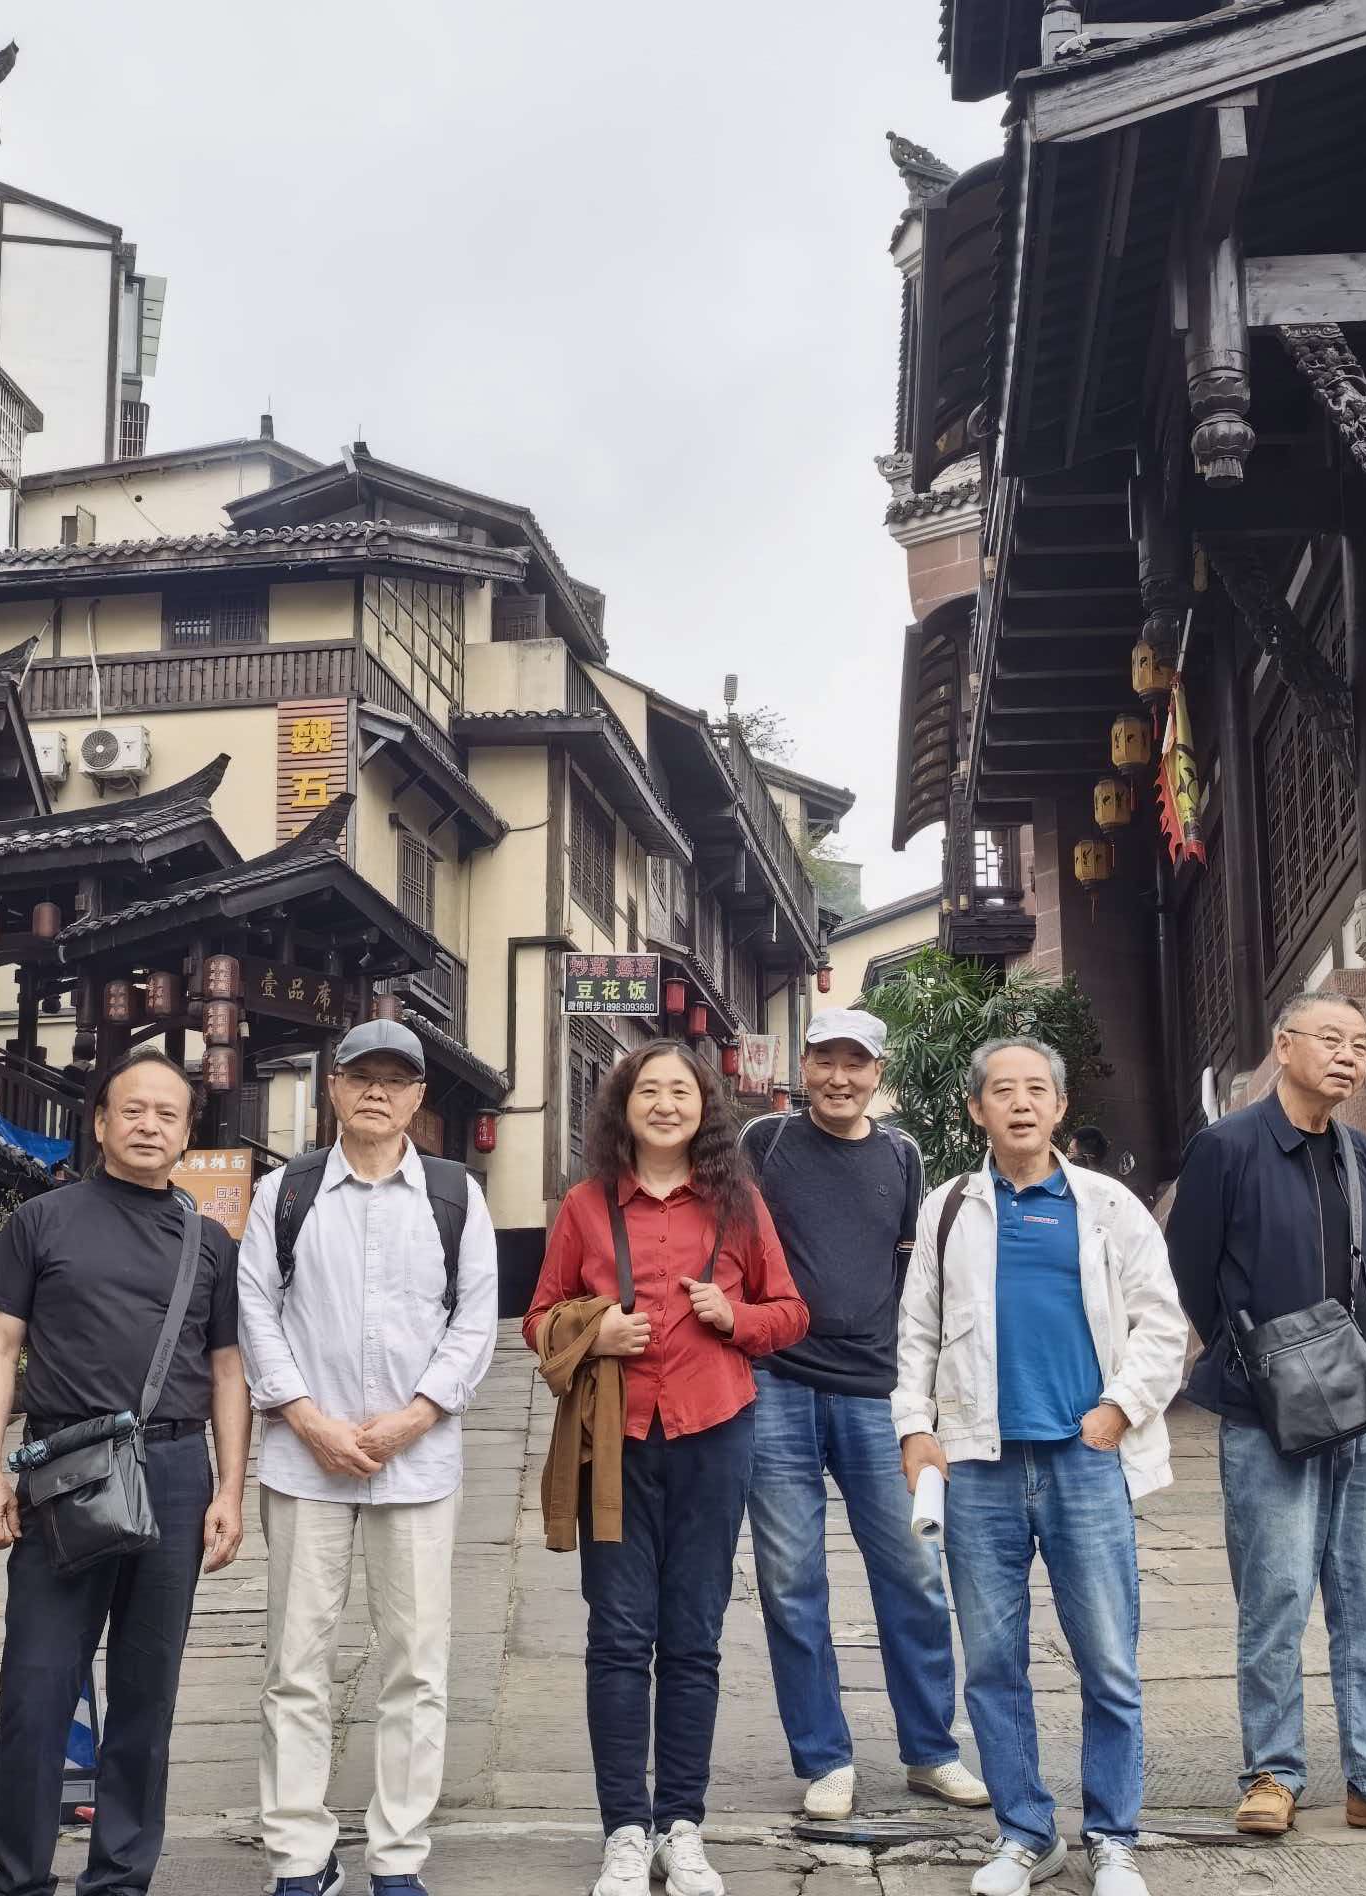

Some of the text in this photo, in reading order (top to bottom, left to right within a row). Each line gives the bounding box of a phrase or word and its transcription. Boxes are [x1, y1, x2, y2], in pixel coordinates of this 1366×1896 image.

[291, 719, 333, 837] 魏五
[575, 980, 646, 1000] 豆花饭
